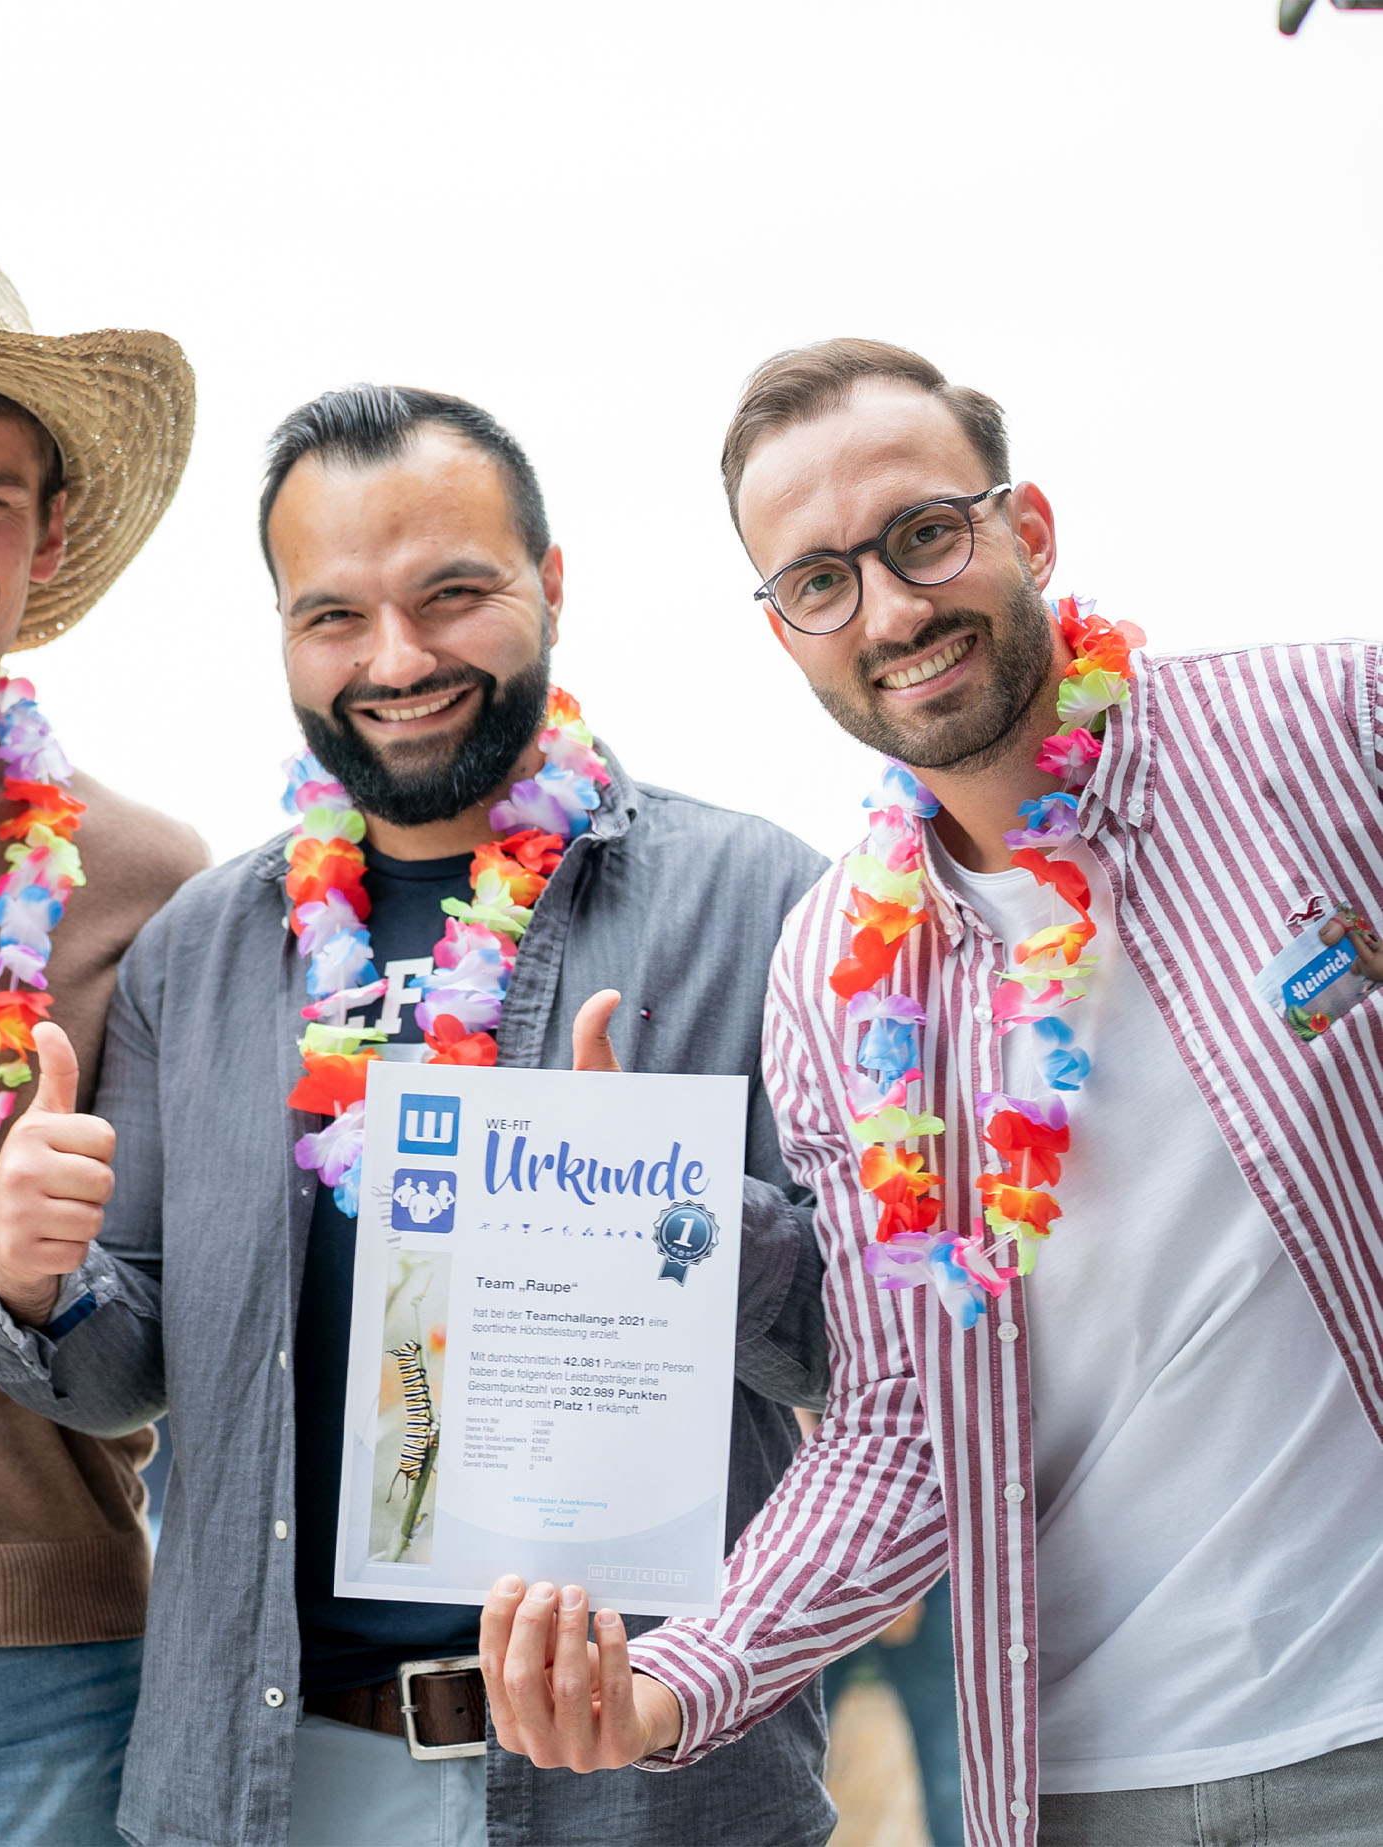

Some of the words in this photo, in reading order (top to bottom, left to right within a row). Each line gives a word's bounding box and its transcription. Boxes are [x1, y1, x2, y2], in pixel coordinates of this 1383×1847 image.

[1290, 949, 1353, 1001] Heinrich
[485, 1117, 532, 1131] WE-FIT
[484, 1129, 711, 1206] Urkunde
[672, 1217, 696, 1248] 1
[475, 1276, 515, 1291] Team
[473, 1308, 488, 1318] hat
[490, 1309, 505, 1319] bei
[507, 1309, 523, 1320] der
[525, 1310, 615, 1327] Teamchallange
[618, 1315, 645, 1326] 2021
[648, 1316, 669, 1328] eine
[472, 1323, 517, 1335] sportliche
[520, 1325, 588, 1340] Höchstleistung
[590, 1329, 621, 1340] erzielt.
[470, 1351, 486, 1361] Mit
[487, 1352, 561, 1366] durchschnittlich
[563, 1356, 601, 1368] 42.081
[604, 1358, 642, 1371] Punkten
[644, 1362, 660, 1373] pro
[662, 1361, 695, 1373] Person
[469, 1366, 498, 1377] haben
[500, 1368, 515, 1378] die
[517, 1368, 563, 1381] folgenden
[565, 1371, 637, 1387] Leistungsträger
[639, 1376, 659, 1386] eine
[468, 1380, 548, 1394] Gesamtpunktzahl
[550, 1386, 567, 1396] von
[570, 1386, 615, 1399] 302.989
[618, 1388, 668, 1401] Punkten
[467, 1396, 503, 1407] erreicht
[505, 1397, 523, 1408] und
[525, 1398, 552, 1409] somit
[554, 1400, 584, 1412] Platz
[587, 1402, 593, 1412] 1
[596, 1403, 641, 1416] erkämpft.
